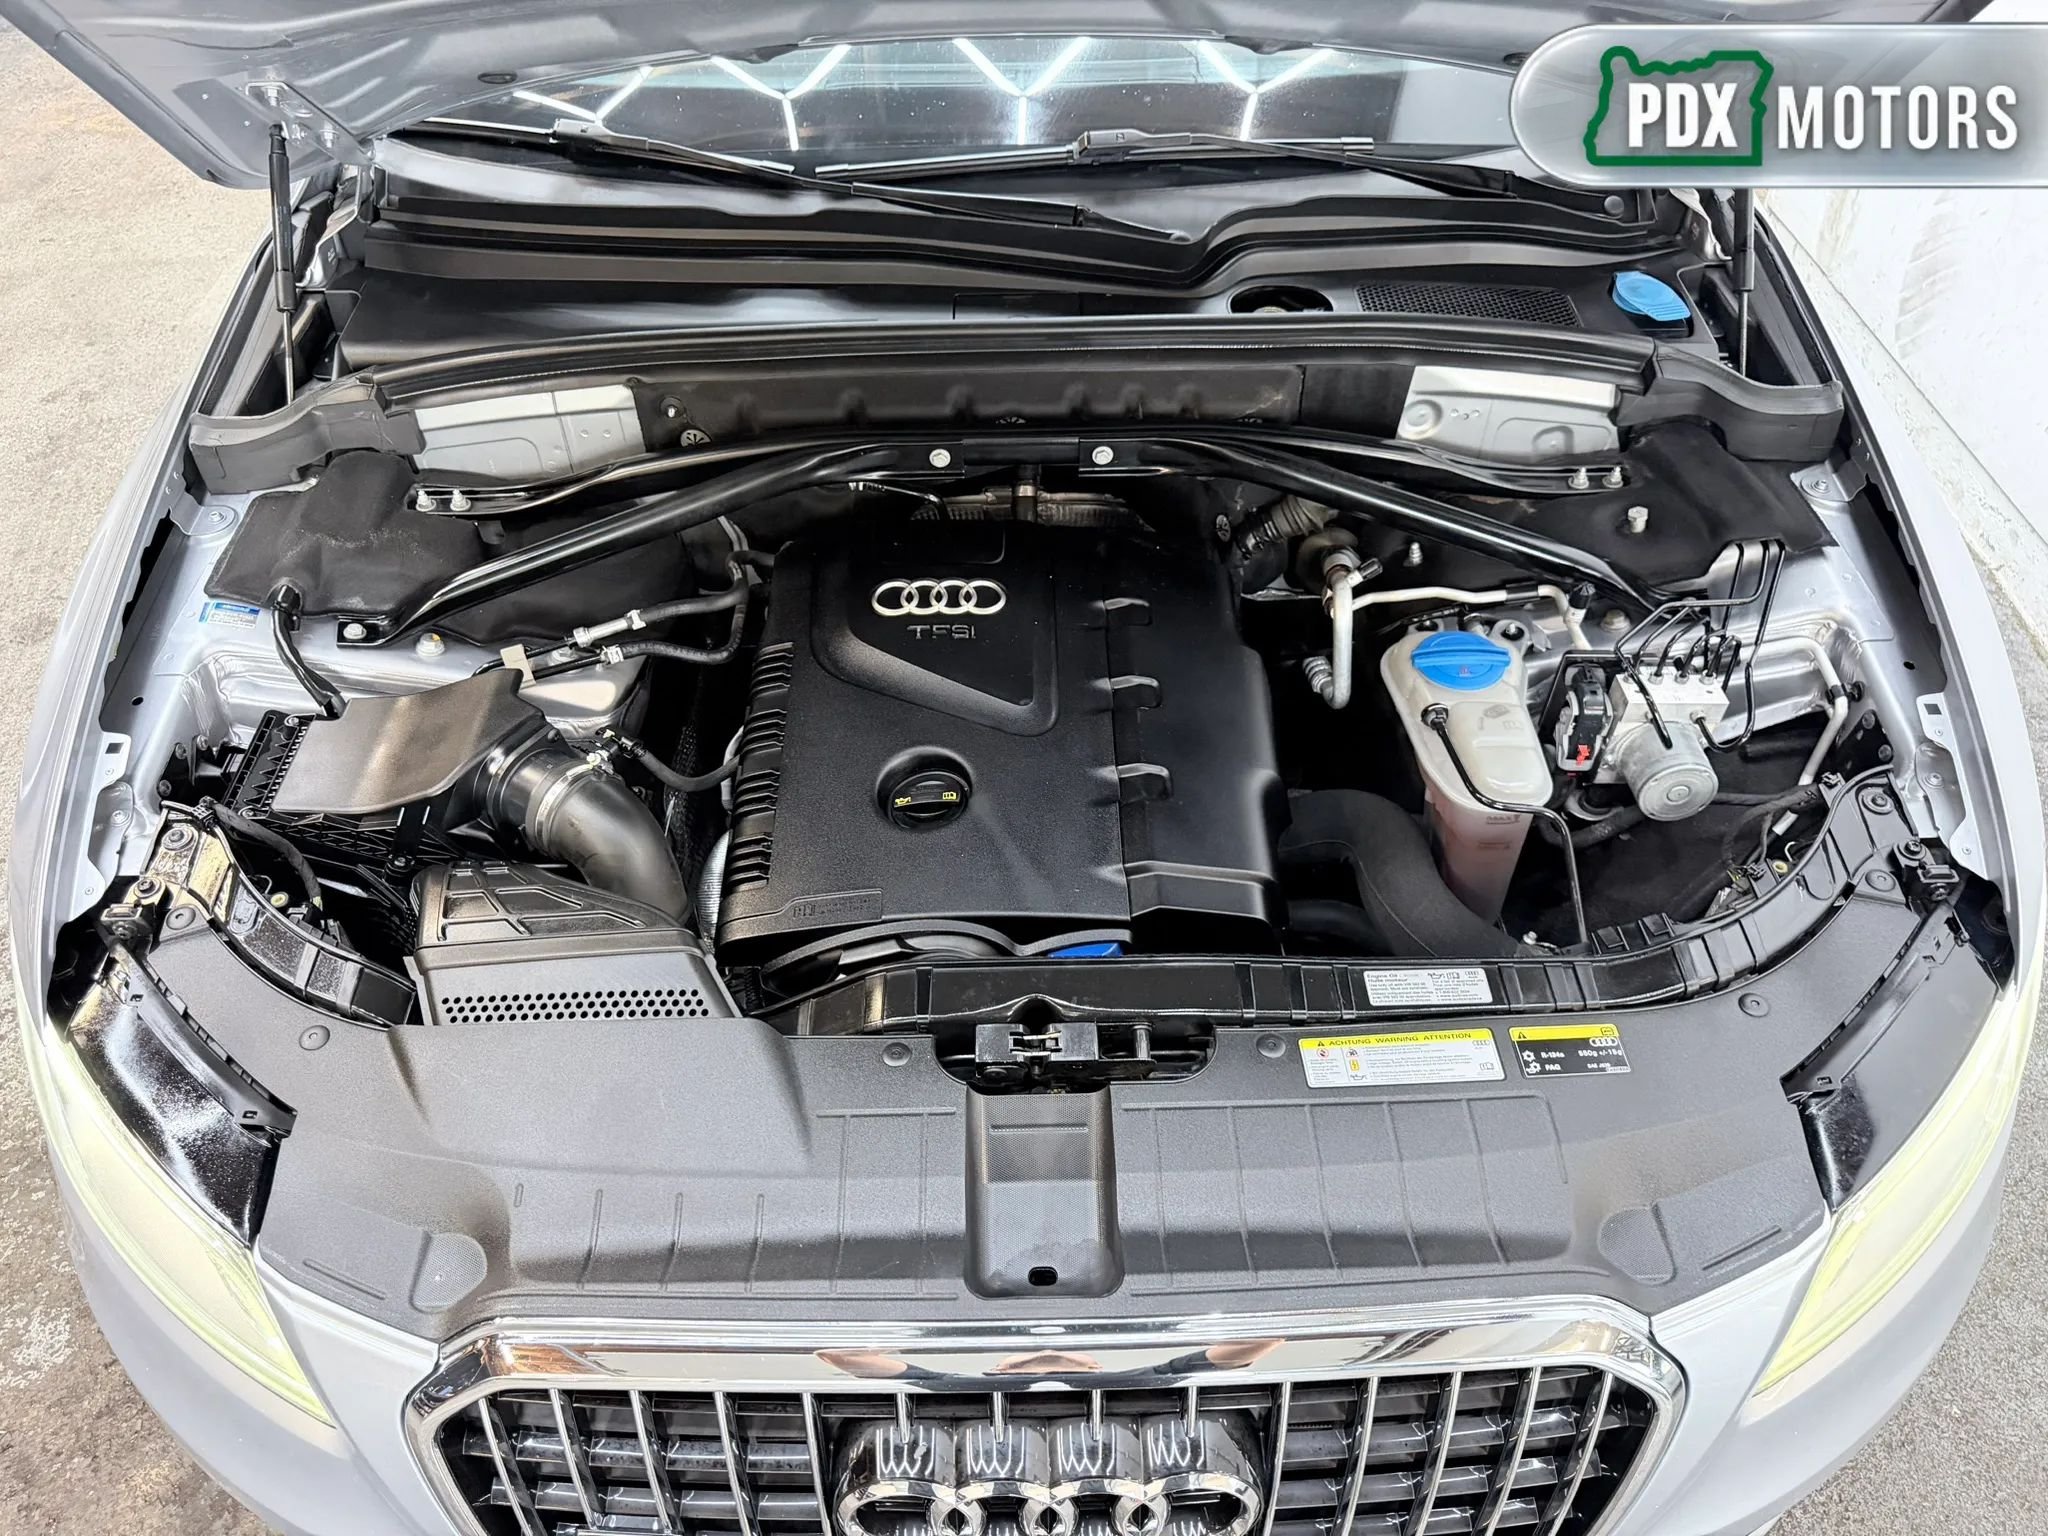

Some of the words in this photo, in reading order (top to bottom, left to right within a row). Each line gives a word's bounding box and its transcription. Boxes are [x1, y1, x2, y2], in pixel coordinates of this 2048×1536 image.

[906, 624, 976, 640] TFSI
[1328, 1038, 1372, 1046] ACHTUNG
[1375, 1036, 1419, 1044] WARNING
[1423, 1033, 1473, 1042] ATTENTION
[1544, 1063, 1562, 1071] PAG
